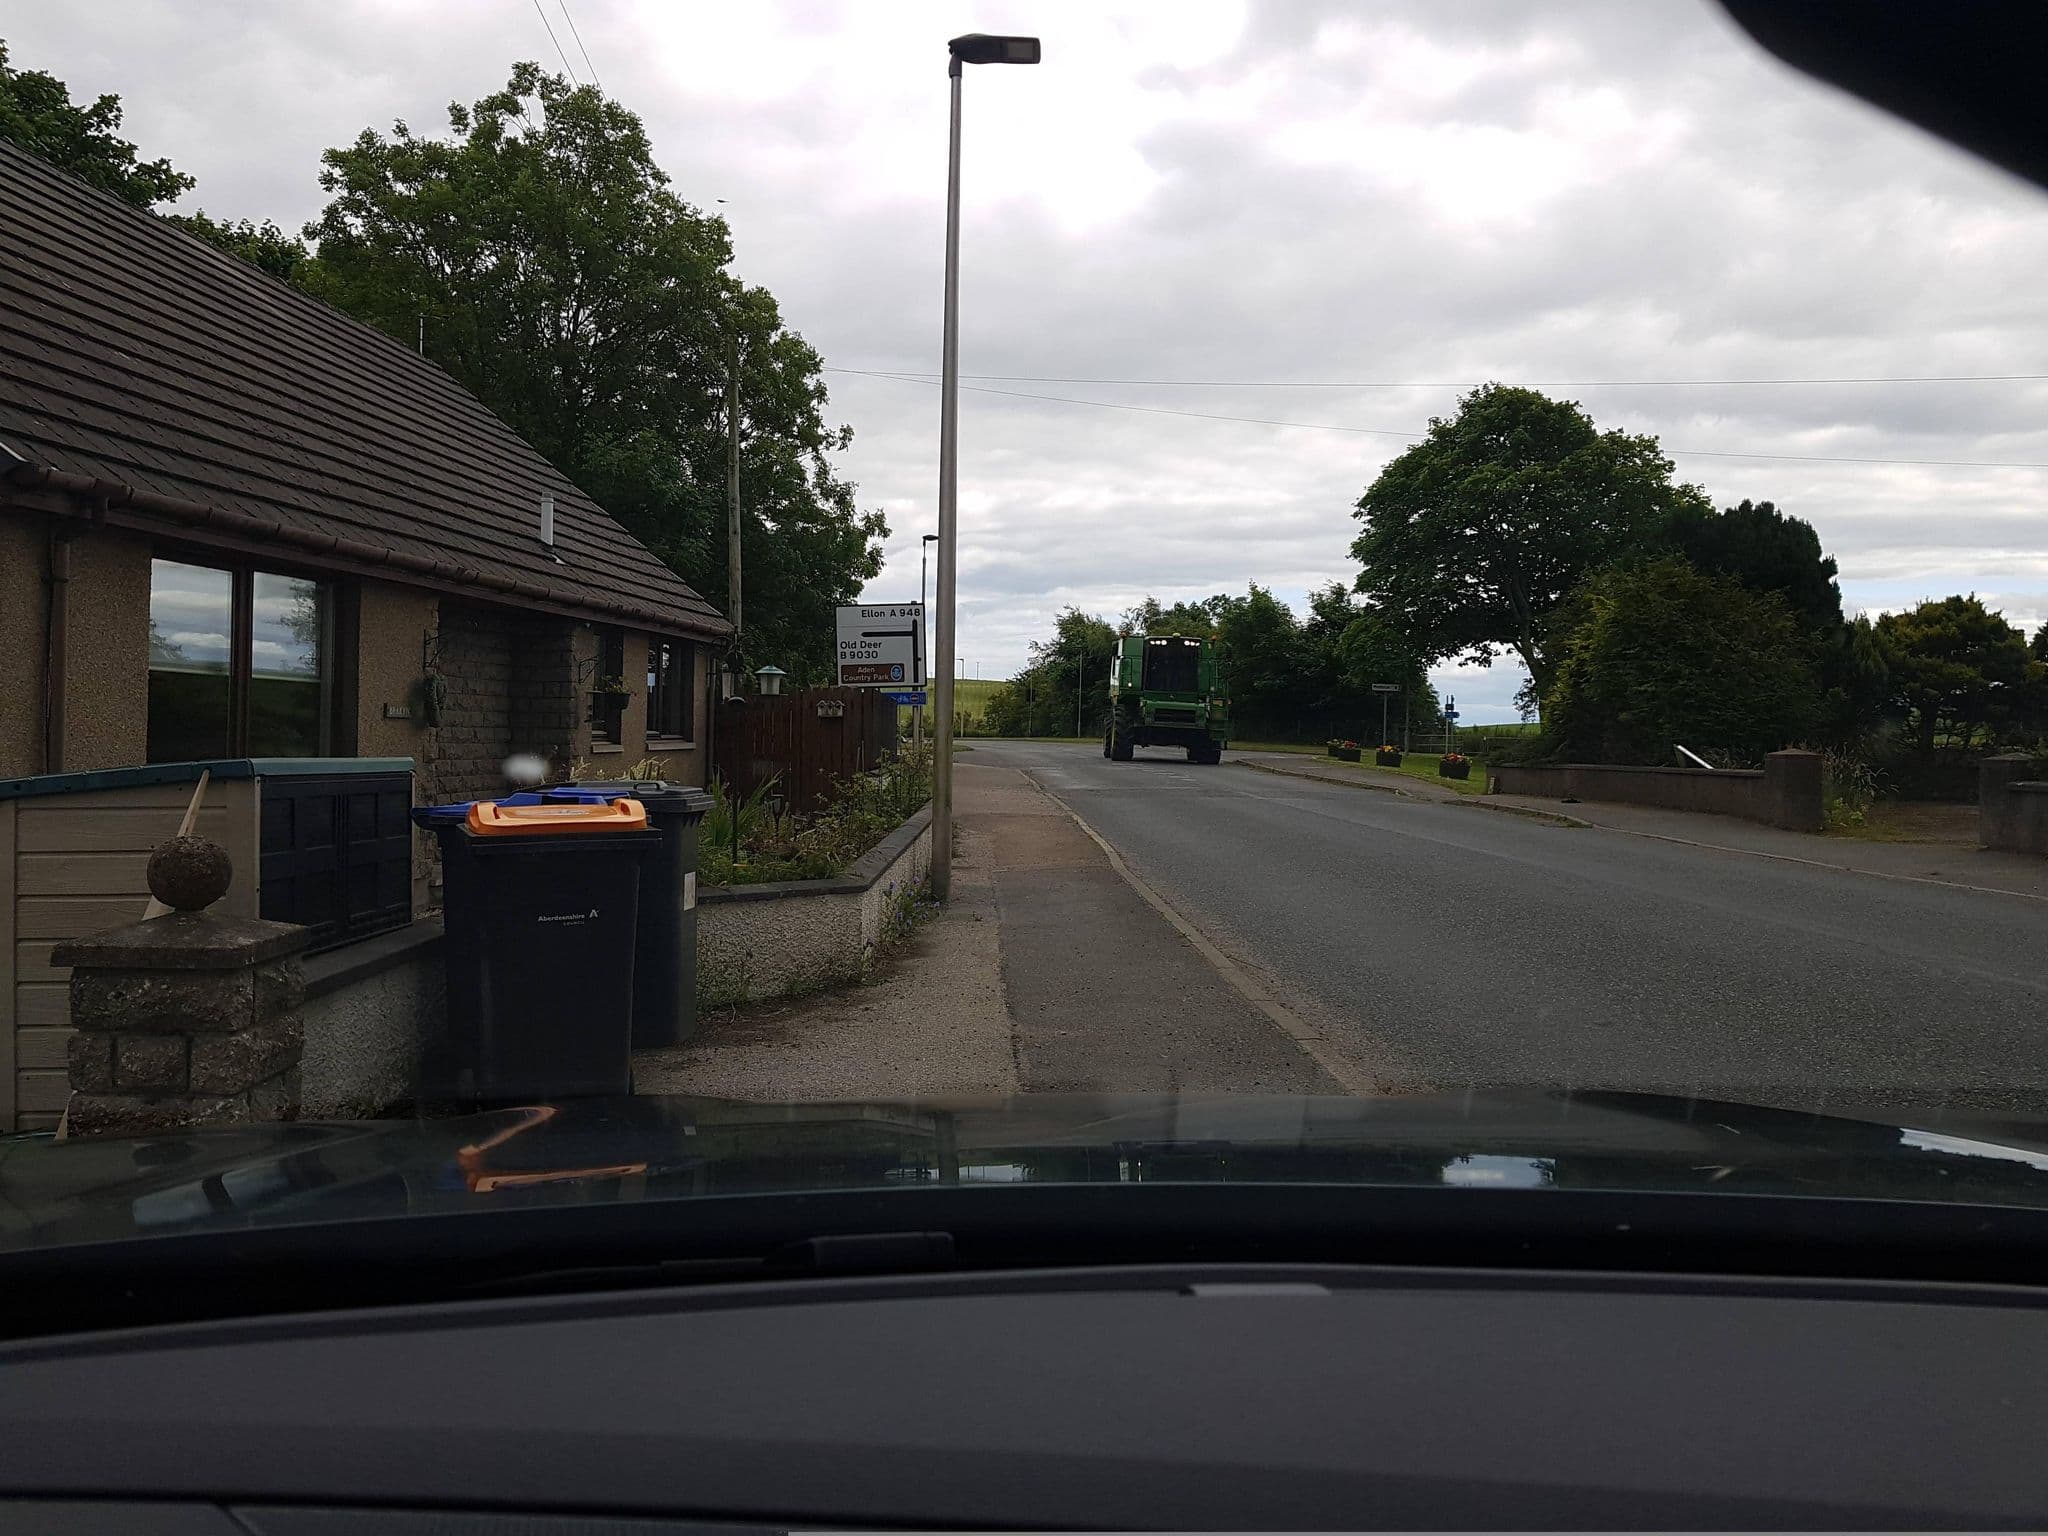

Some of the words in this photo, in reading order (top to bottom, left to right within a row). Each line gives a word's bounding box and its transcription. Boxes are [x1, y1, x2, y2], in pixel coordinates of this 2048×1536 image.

[861, 610, 885, 618] Ellon
[890, 609, 897, 617] A
[900, 608, 921, 617] 948
[840, 641, 857, 649] Old
[860, 640, 882, 649] Deer
[840, 651, 847, 659] B
[849, 650, 879, 659] 9030
[843, 674, 871, 682] Country
[873, 673, 890, 681] Park
[538, 913, 585, 922] Aberdeenshire
